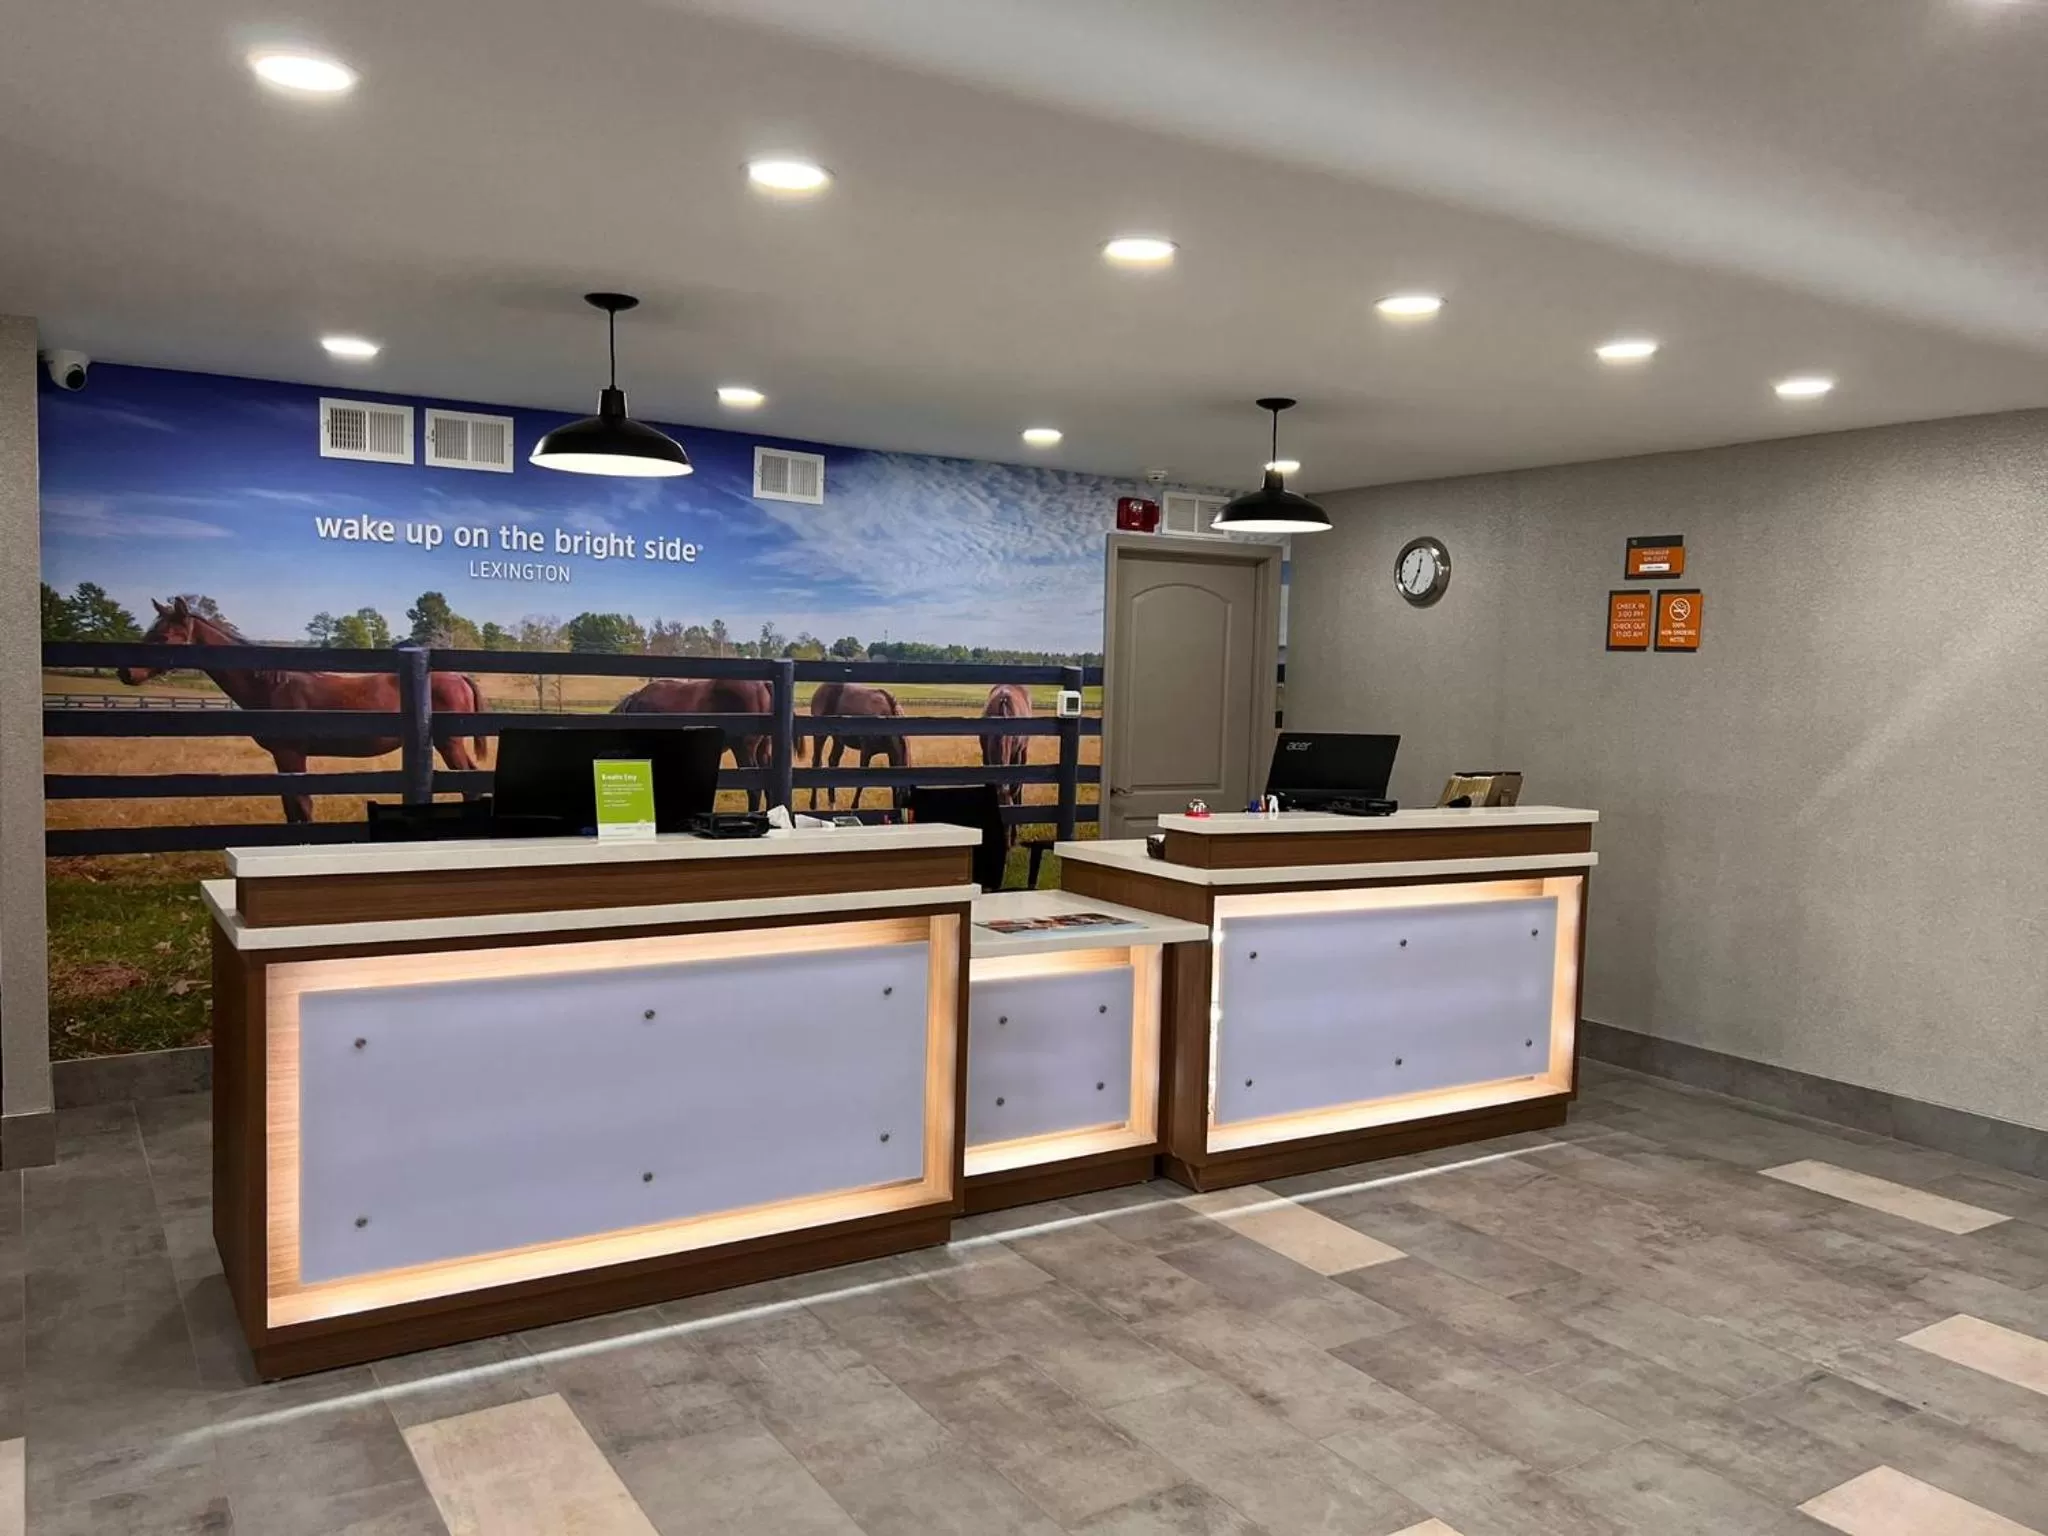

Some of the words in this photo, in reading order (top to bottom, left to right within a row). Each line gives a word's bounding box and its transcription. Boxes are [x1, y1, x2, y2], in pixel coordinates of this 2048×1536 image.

[315, 513, 396, 543] wake
[406, 522, 444, 551] up
[454, 526, 489, 549] on
[499, 523, 545, 552] the
[554, 528, 636, 560] bright
[469, 560, 571, 583] LEXINGTON
[1616, 602, 1637, 610] CHECK
[1633, 622, 1646, 630] OUT
[1286, 742, 1312, 751] acer
